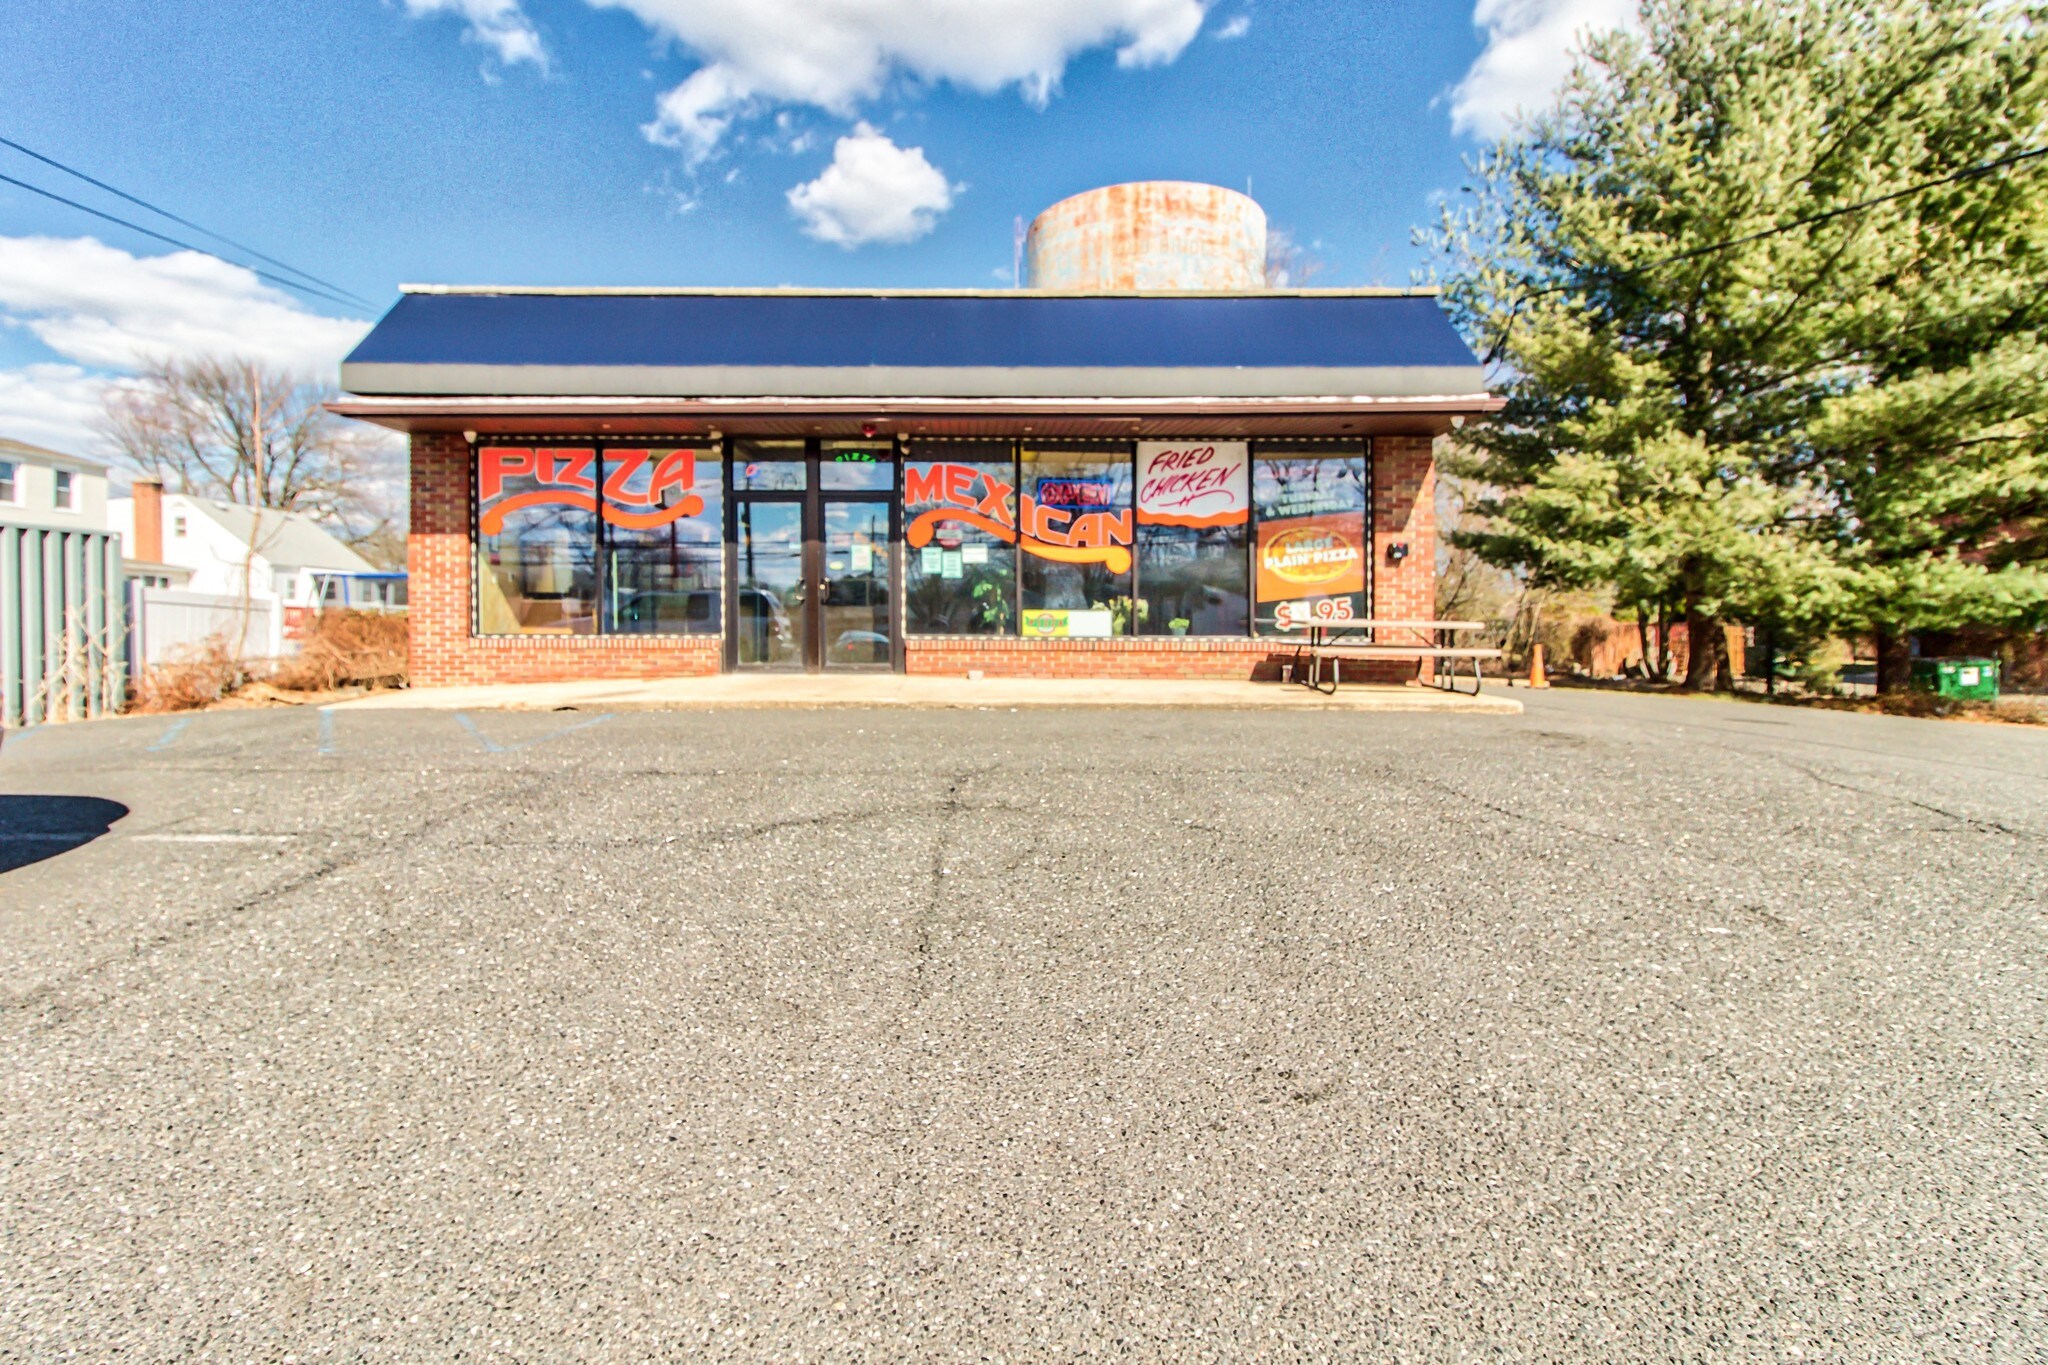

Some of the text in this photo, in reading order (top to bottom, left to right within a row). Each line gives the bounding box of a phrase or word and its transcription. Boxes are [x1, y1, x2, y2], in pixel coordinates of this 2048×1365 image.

[1147, 446, 1215, 475] FRIED
[478, 447, 696, 506] PIZZA
[1141, 462, 1242, 503] CHICKEN
[904, 464, 1133, 548] MEXICAN
[1041, 482, 1111, 506] OPEN
[1264, 546, 1359, 570] PLAIN PIZZA
[1285, 536, 1333, 554] LARGE
